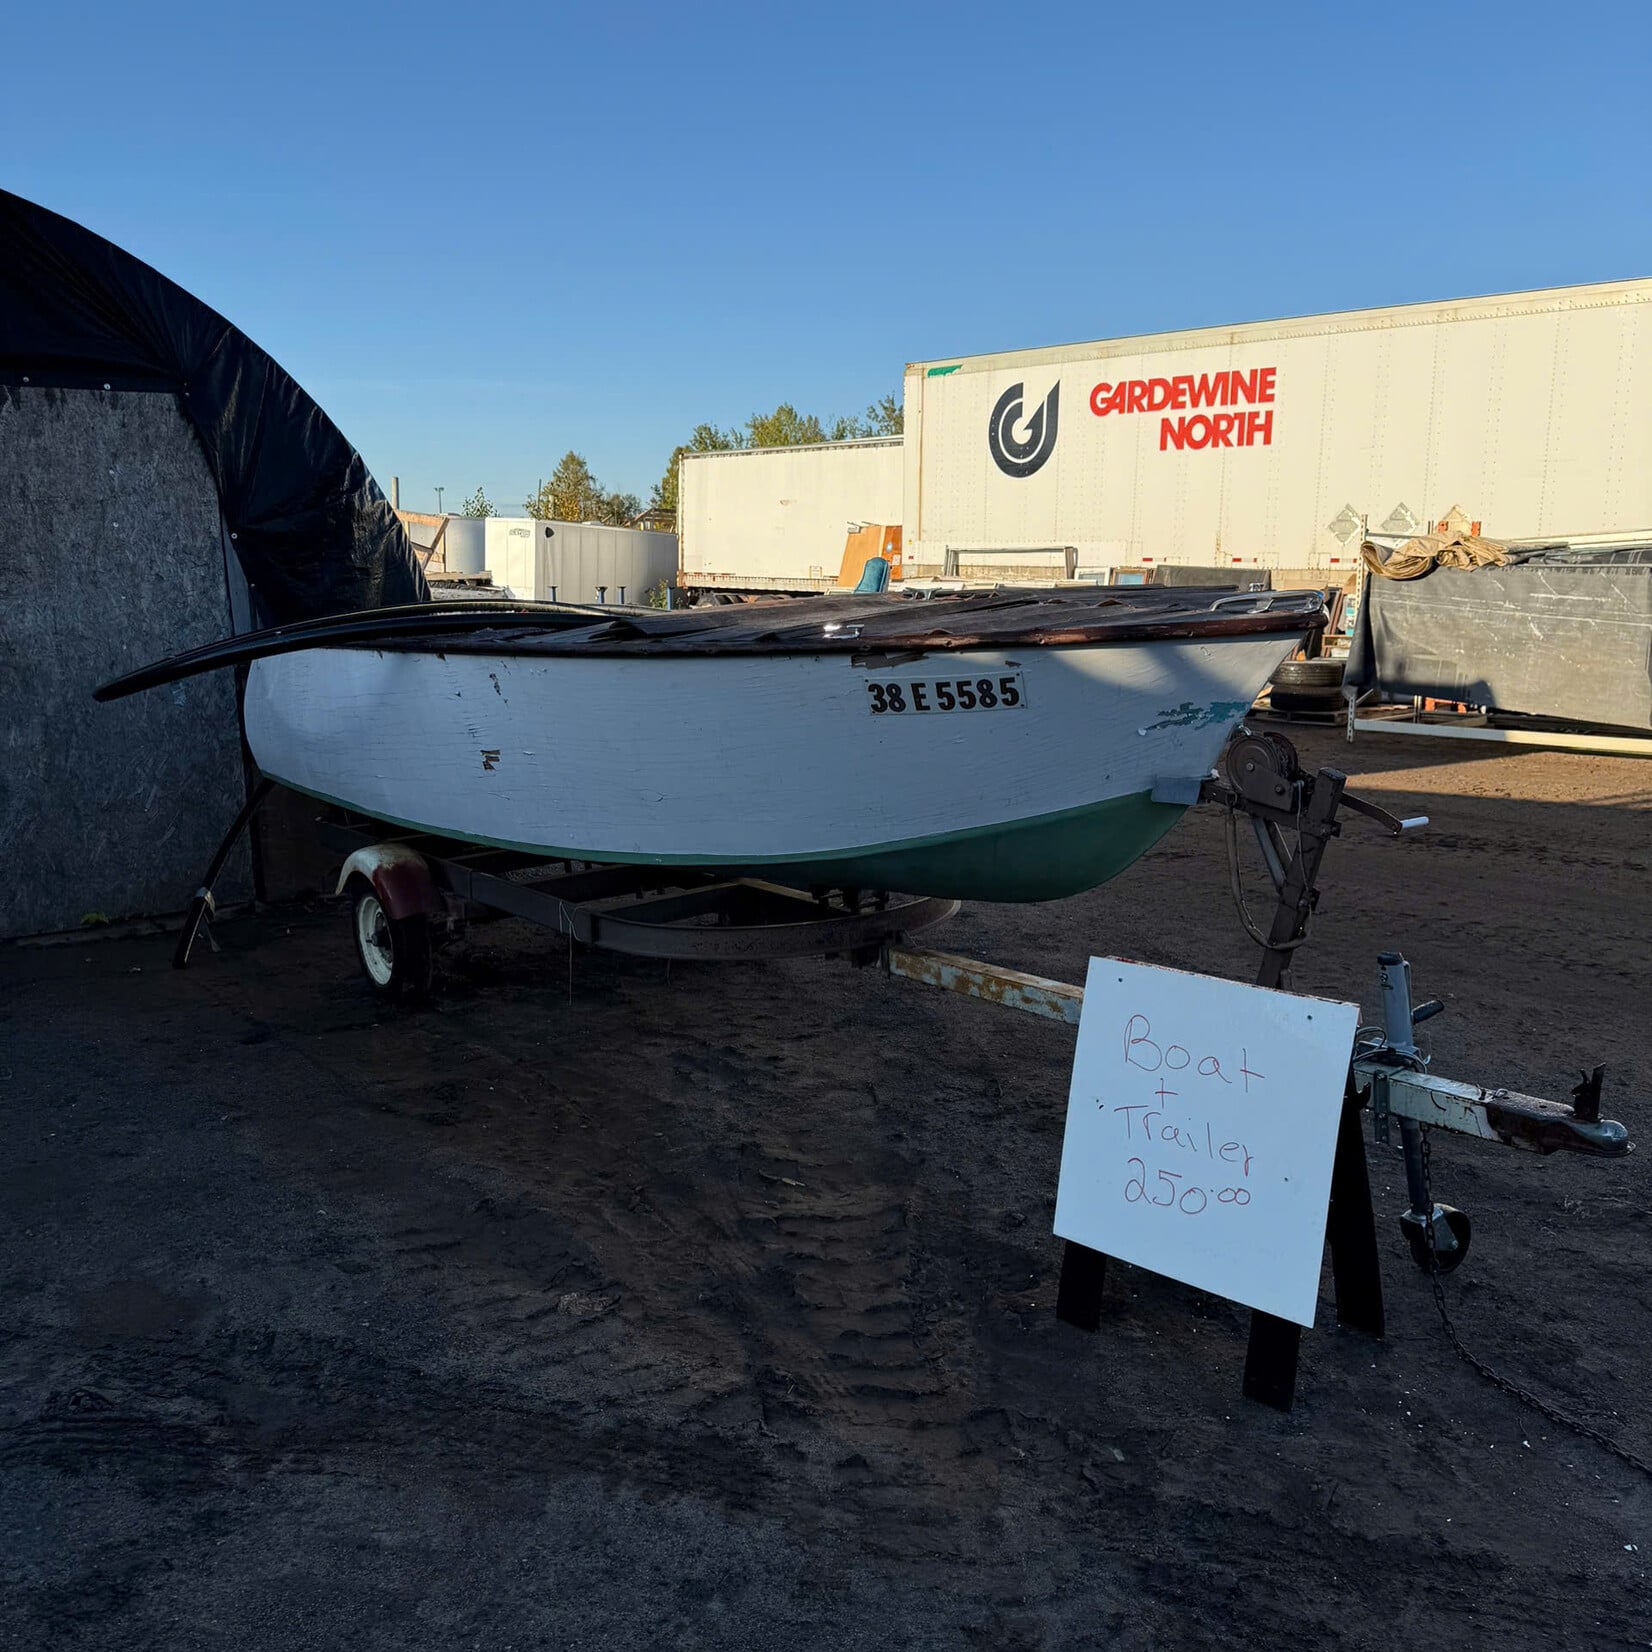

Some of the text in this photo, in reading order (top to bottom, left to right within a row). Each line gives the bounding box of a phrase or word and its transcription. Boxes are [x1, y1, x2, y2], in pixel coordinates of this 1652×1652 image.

[1089, 367, 1277, 417] GARDEWINE
[1159, 410, 1274, 451] NORTH
[868, 676, 1020, 713] 38 E 5585
[1124, 1014, 1265, 1093] Boat
[1114, 1105, 1254, 1176] Trailer
